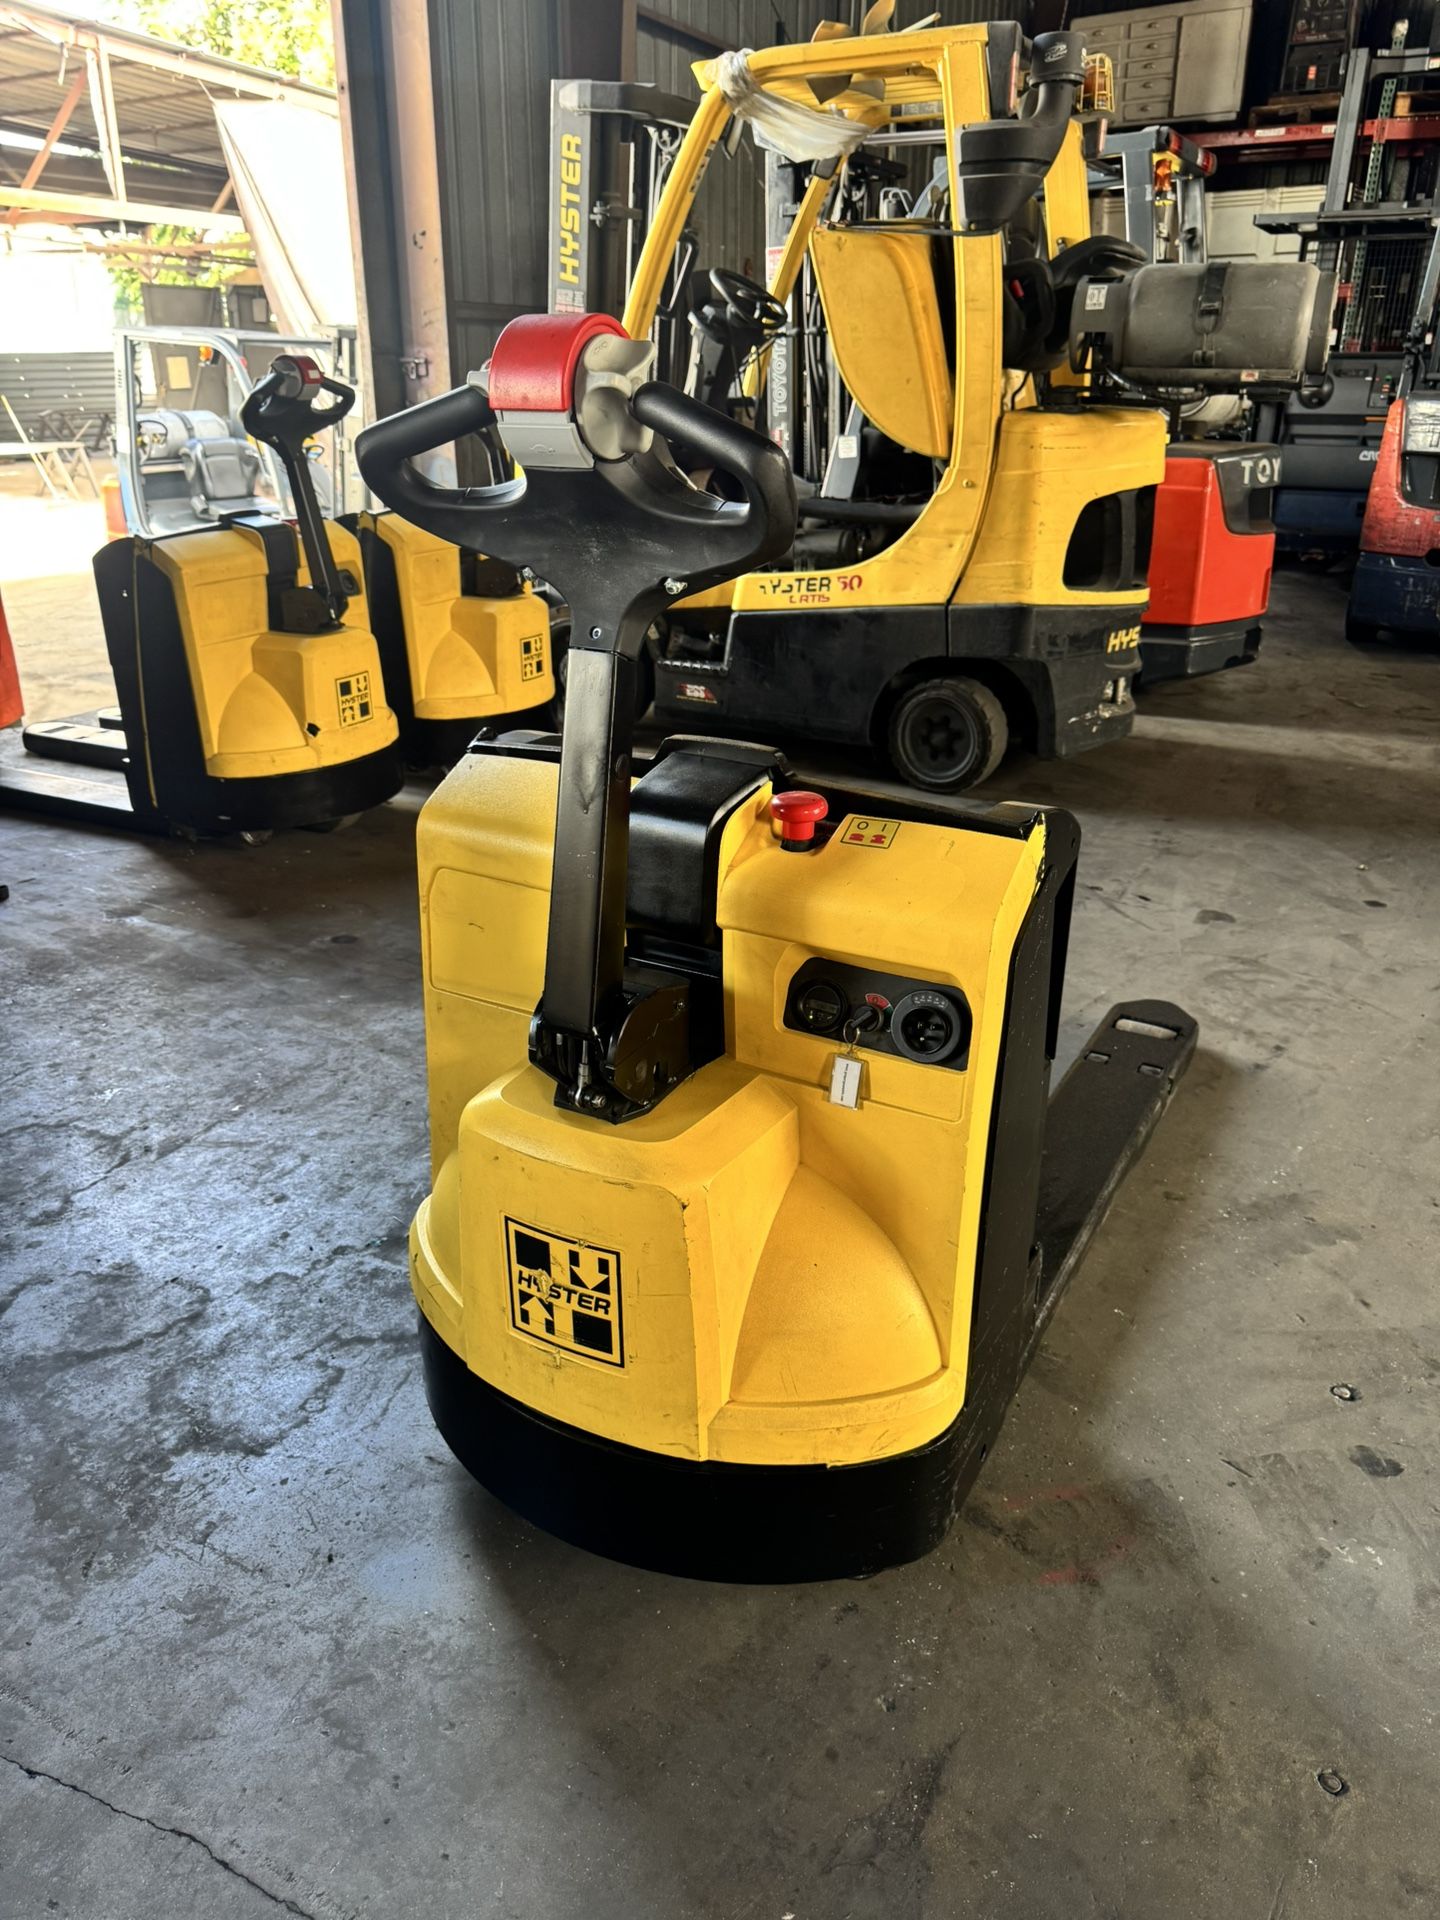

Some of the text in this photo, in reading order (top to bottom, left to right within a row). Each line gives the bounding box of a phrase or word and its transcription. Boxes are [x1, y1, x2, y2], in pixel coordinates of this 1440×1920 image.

[559, 133, 582, 285] HYSTER
[1241, 457, 1281, 485] TOY
[837, 575, 863, 591] 50
[1107, 625, 1142, 654] HYS
